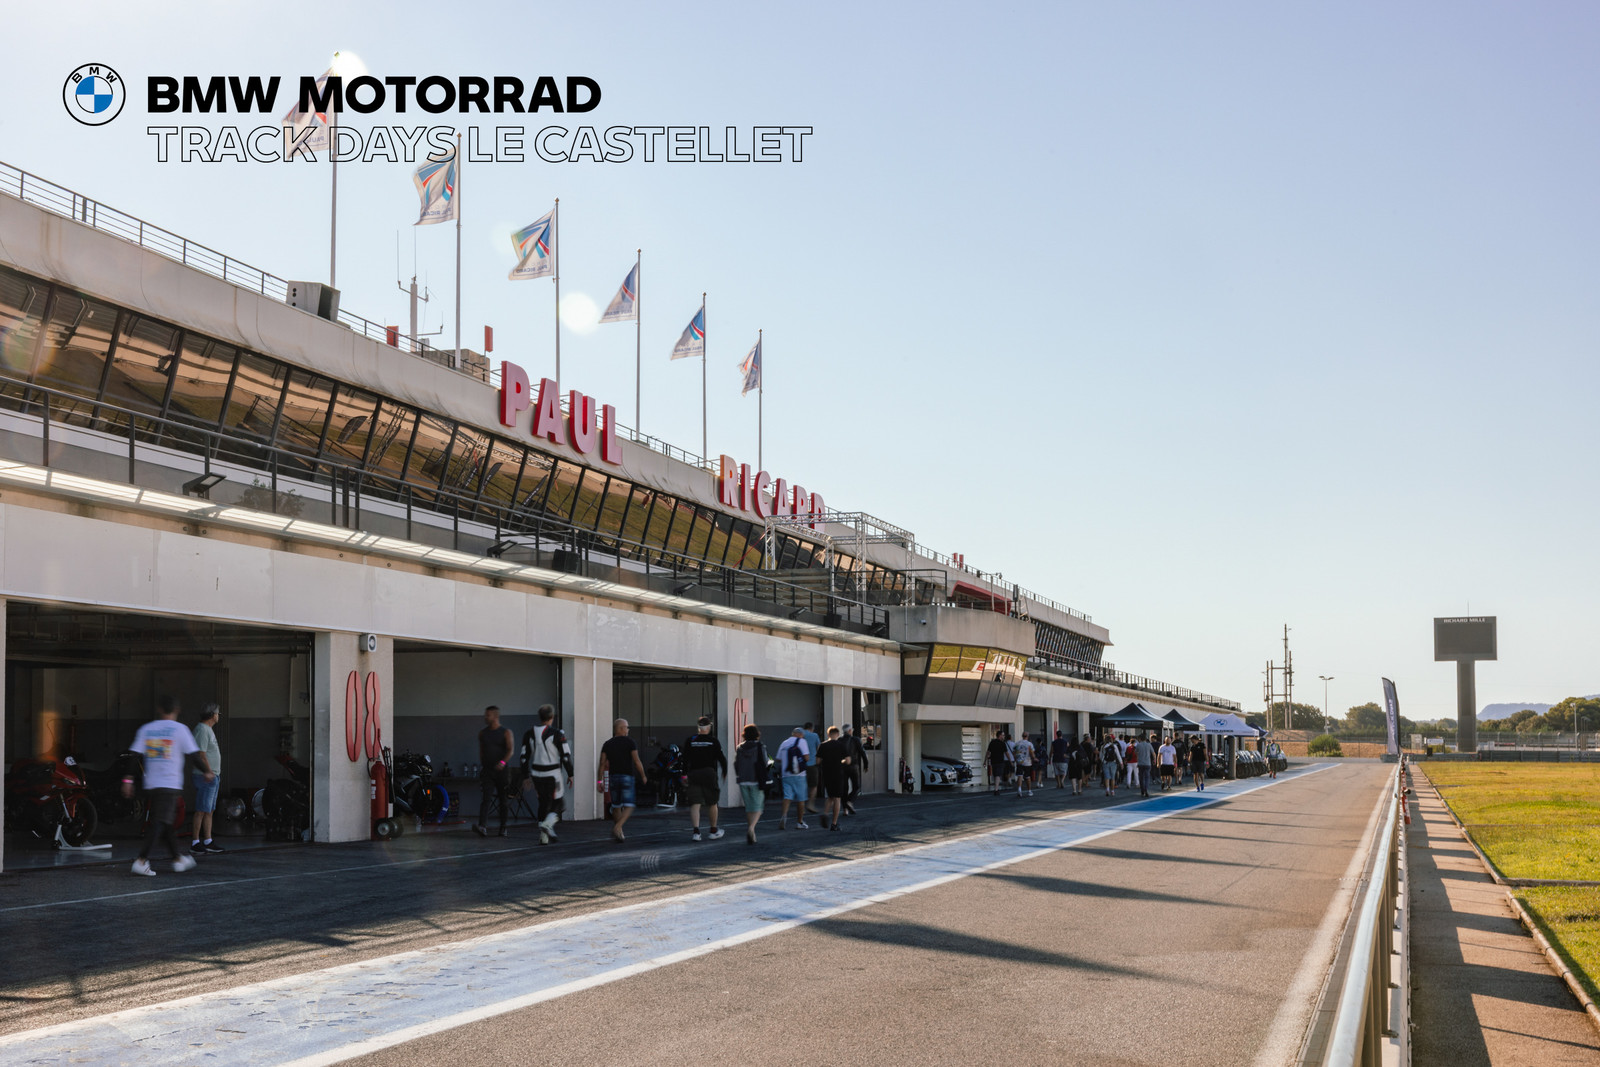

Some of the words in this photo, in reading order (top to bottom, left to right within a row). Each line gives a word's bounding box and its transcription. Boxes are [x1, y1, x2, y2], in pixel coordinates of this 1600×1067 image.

[500, 360, 623, 465] PAUL
[719, 454, 826, 533] RICARD
[345, 670, 381, 762] 08
